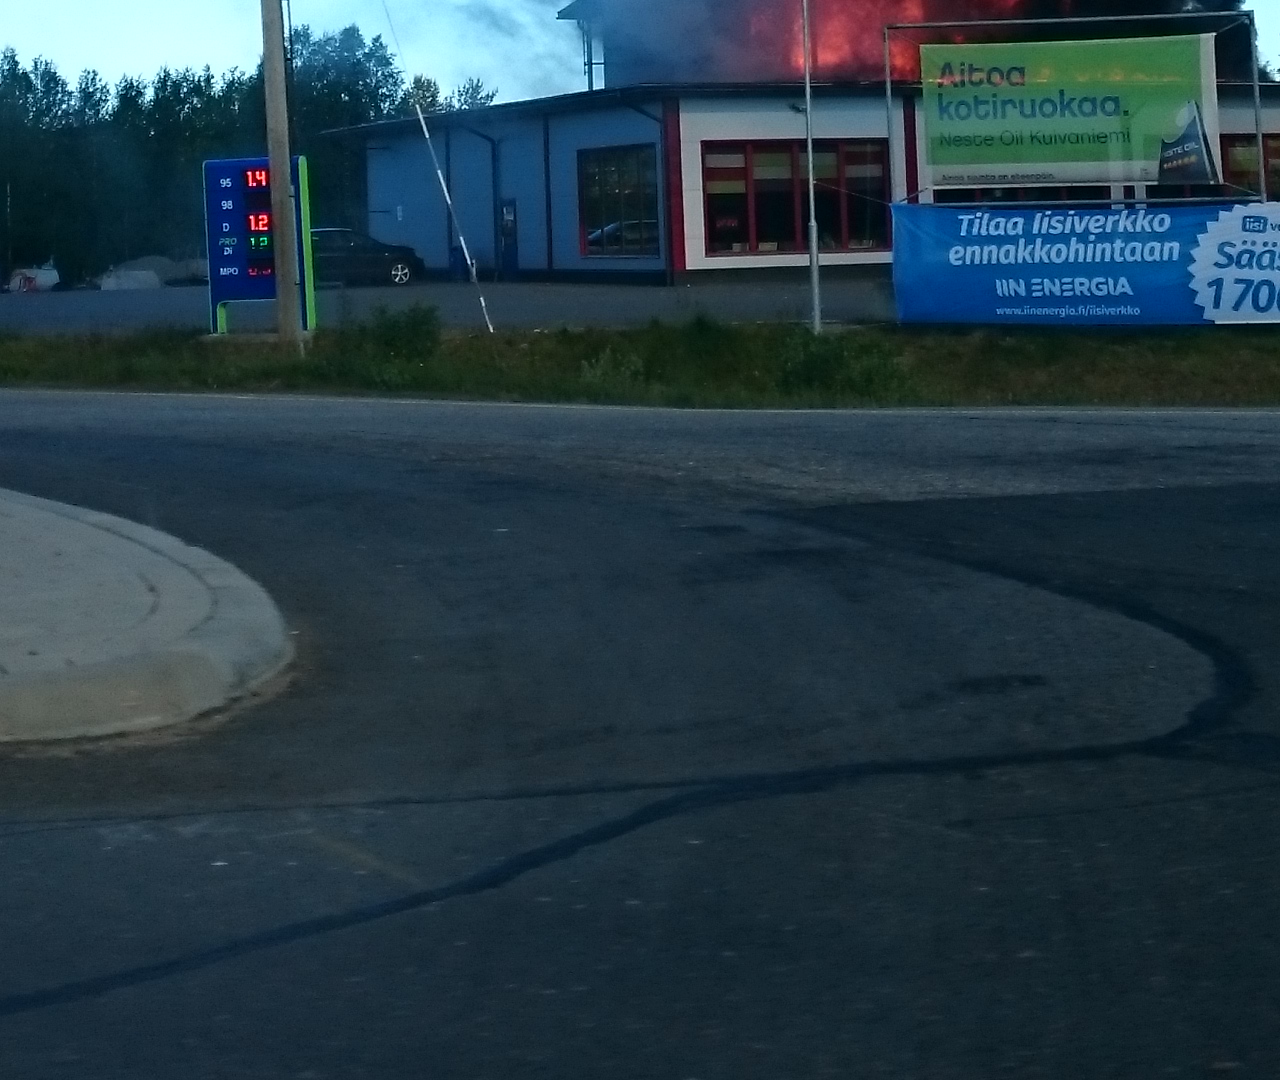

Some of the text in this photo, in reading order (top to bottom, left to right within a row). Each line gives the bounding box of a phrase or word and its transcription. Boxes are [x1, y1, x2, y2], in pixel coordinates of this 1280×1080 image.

[937, 62, 1026, 89] Aitoa
[937, 89, 1131, 121] kotiruokaa.
[939, 126, 1132, 147] Neste Oil Kuivaniemi
[220, 178, 233, 188] 95
[221, 200, 234, 210] 98
[222, 222, 230, 232] D
[957, 210, 1171, 237] Tilaa Iisiverkko
[948, 234, 1181, 266] ennakkohintaan
[220, 267, 239, 276] MPO
[995, 276, 1134, 298] IIN ENERGIA
